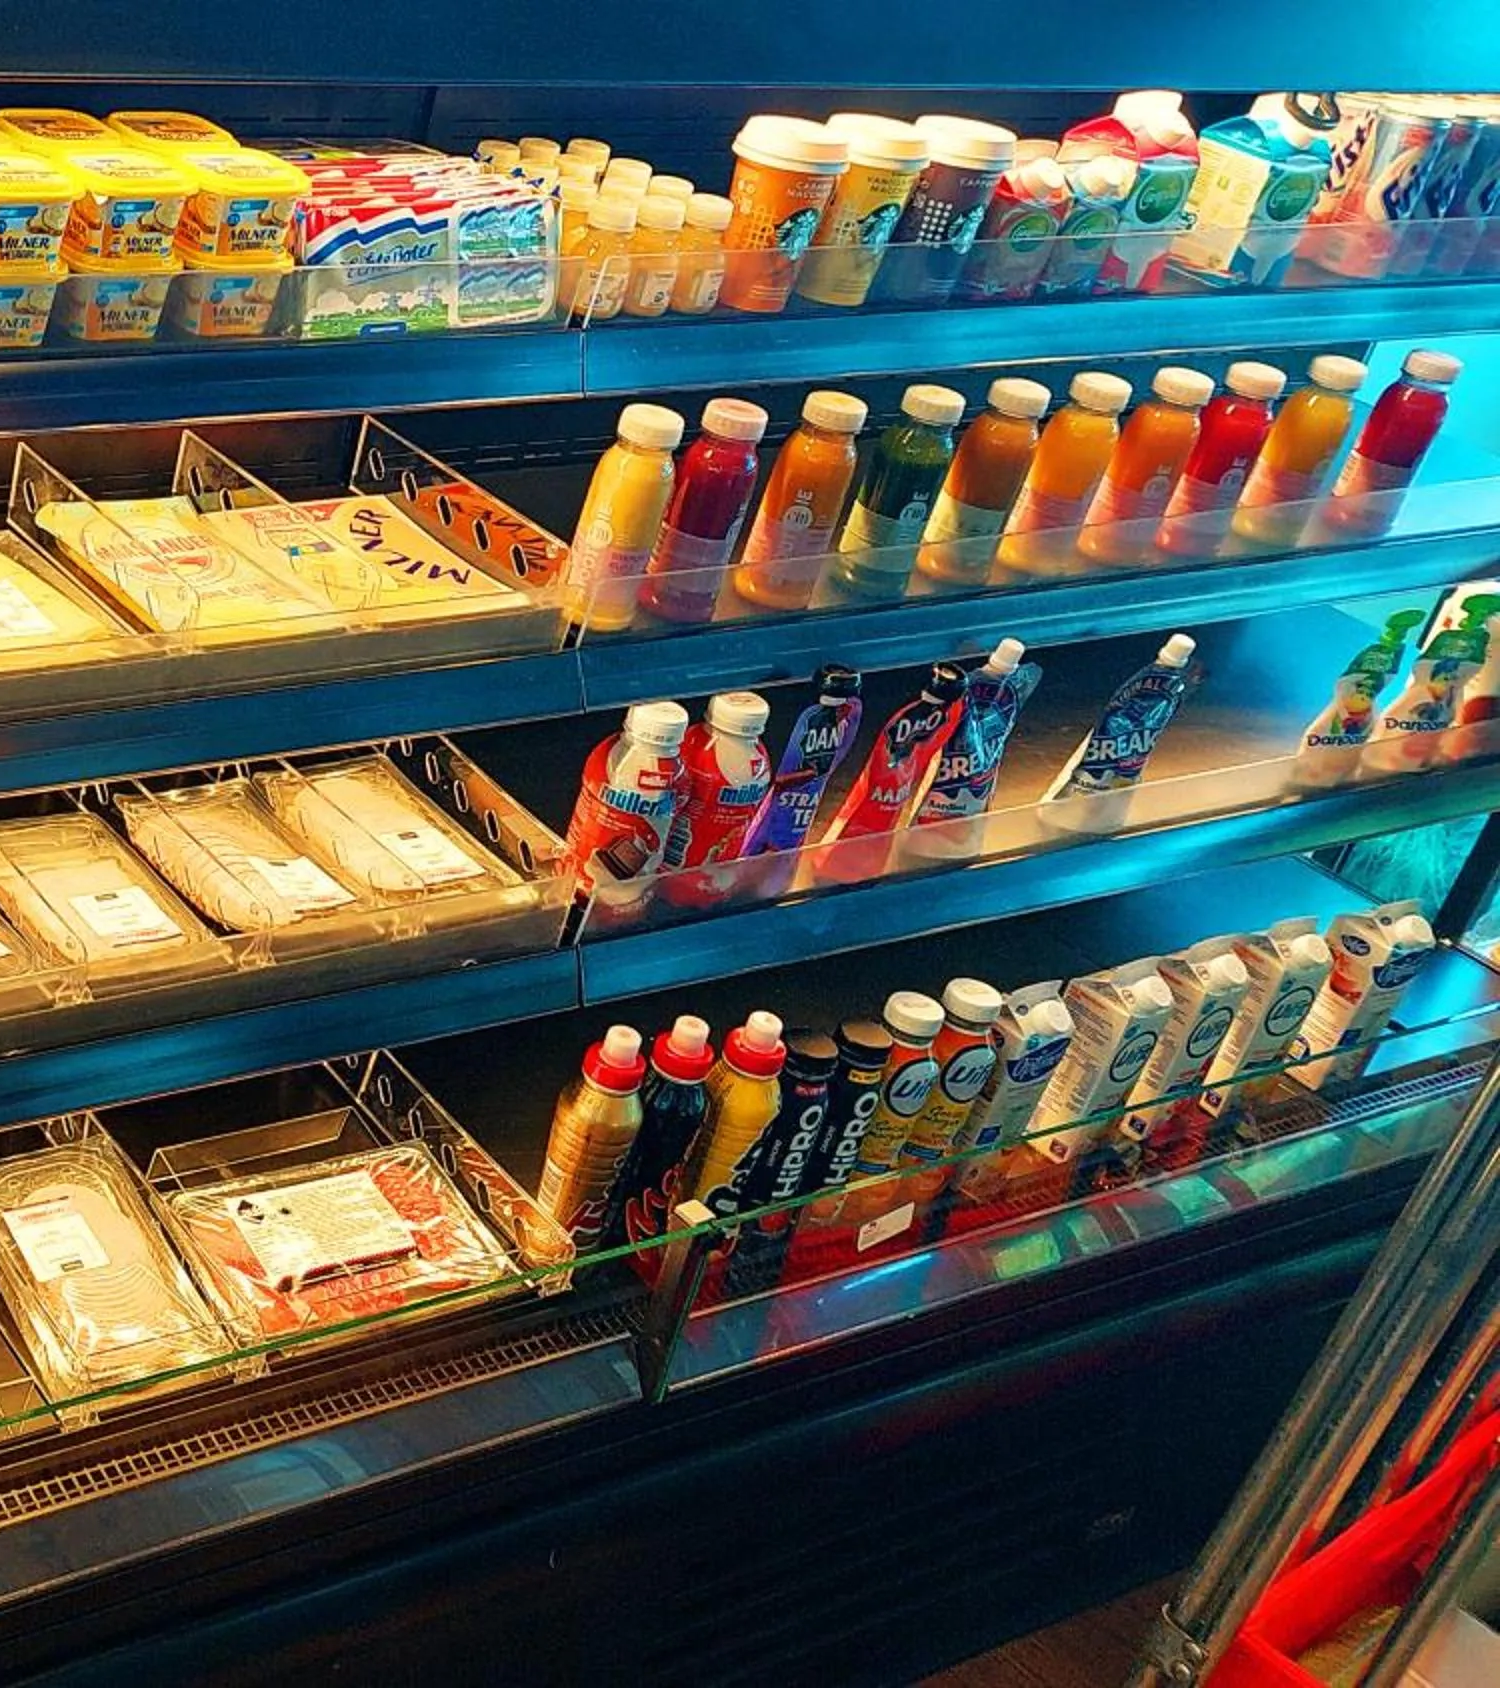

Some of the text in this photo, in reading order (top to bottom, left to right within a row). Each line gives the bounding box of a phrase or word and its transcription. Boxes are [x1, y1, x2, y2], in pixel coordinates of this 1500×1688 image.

[228, 228, 278, 241] MILNER
[98, 308, 150, 322] MILNER
[348, 509, 471, 586] MILNER
[771, 1104, 824, 1198] HiPRO
[823, 1091, 880, 1185] HiPRO
